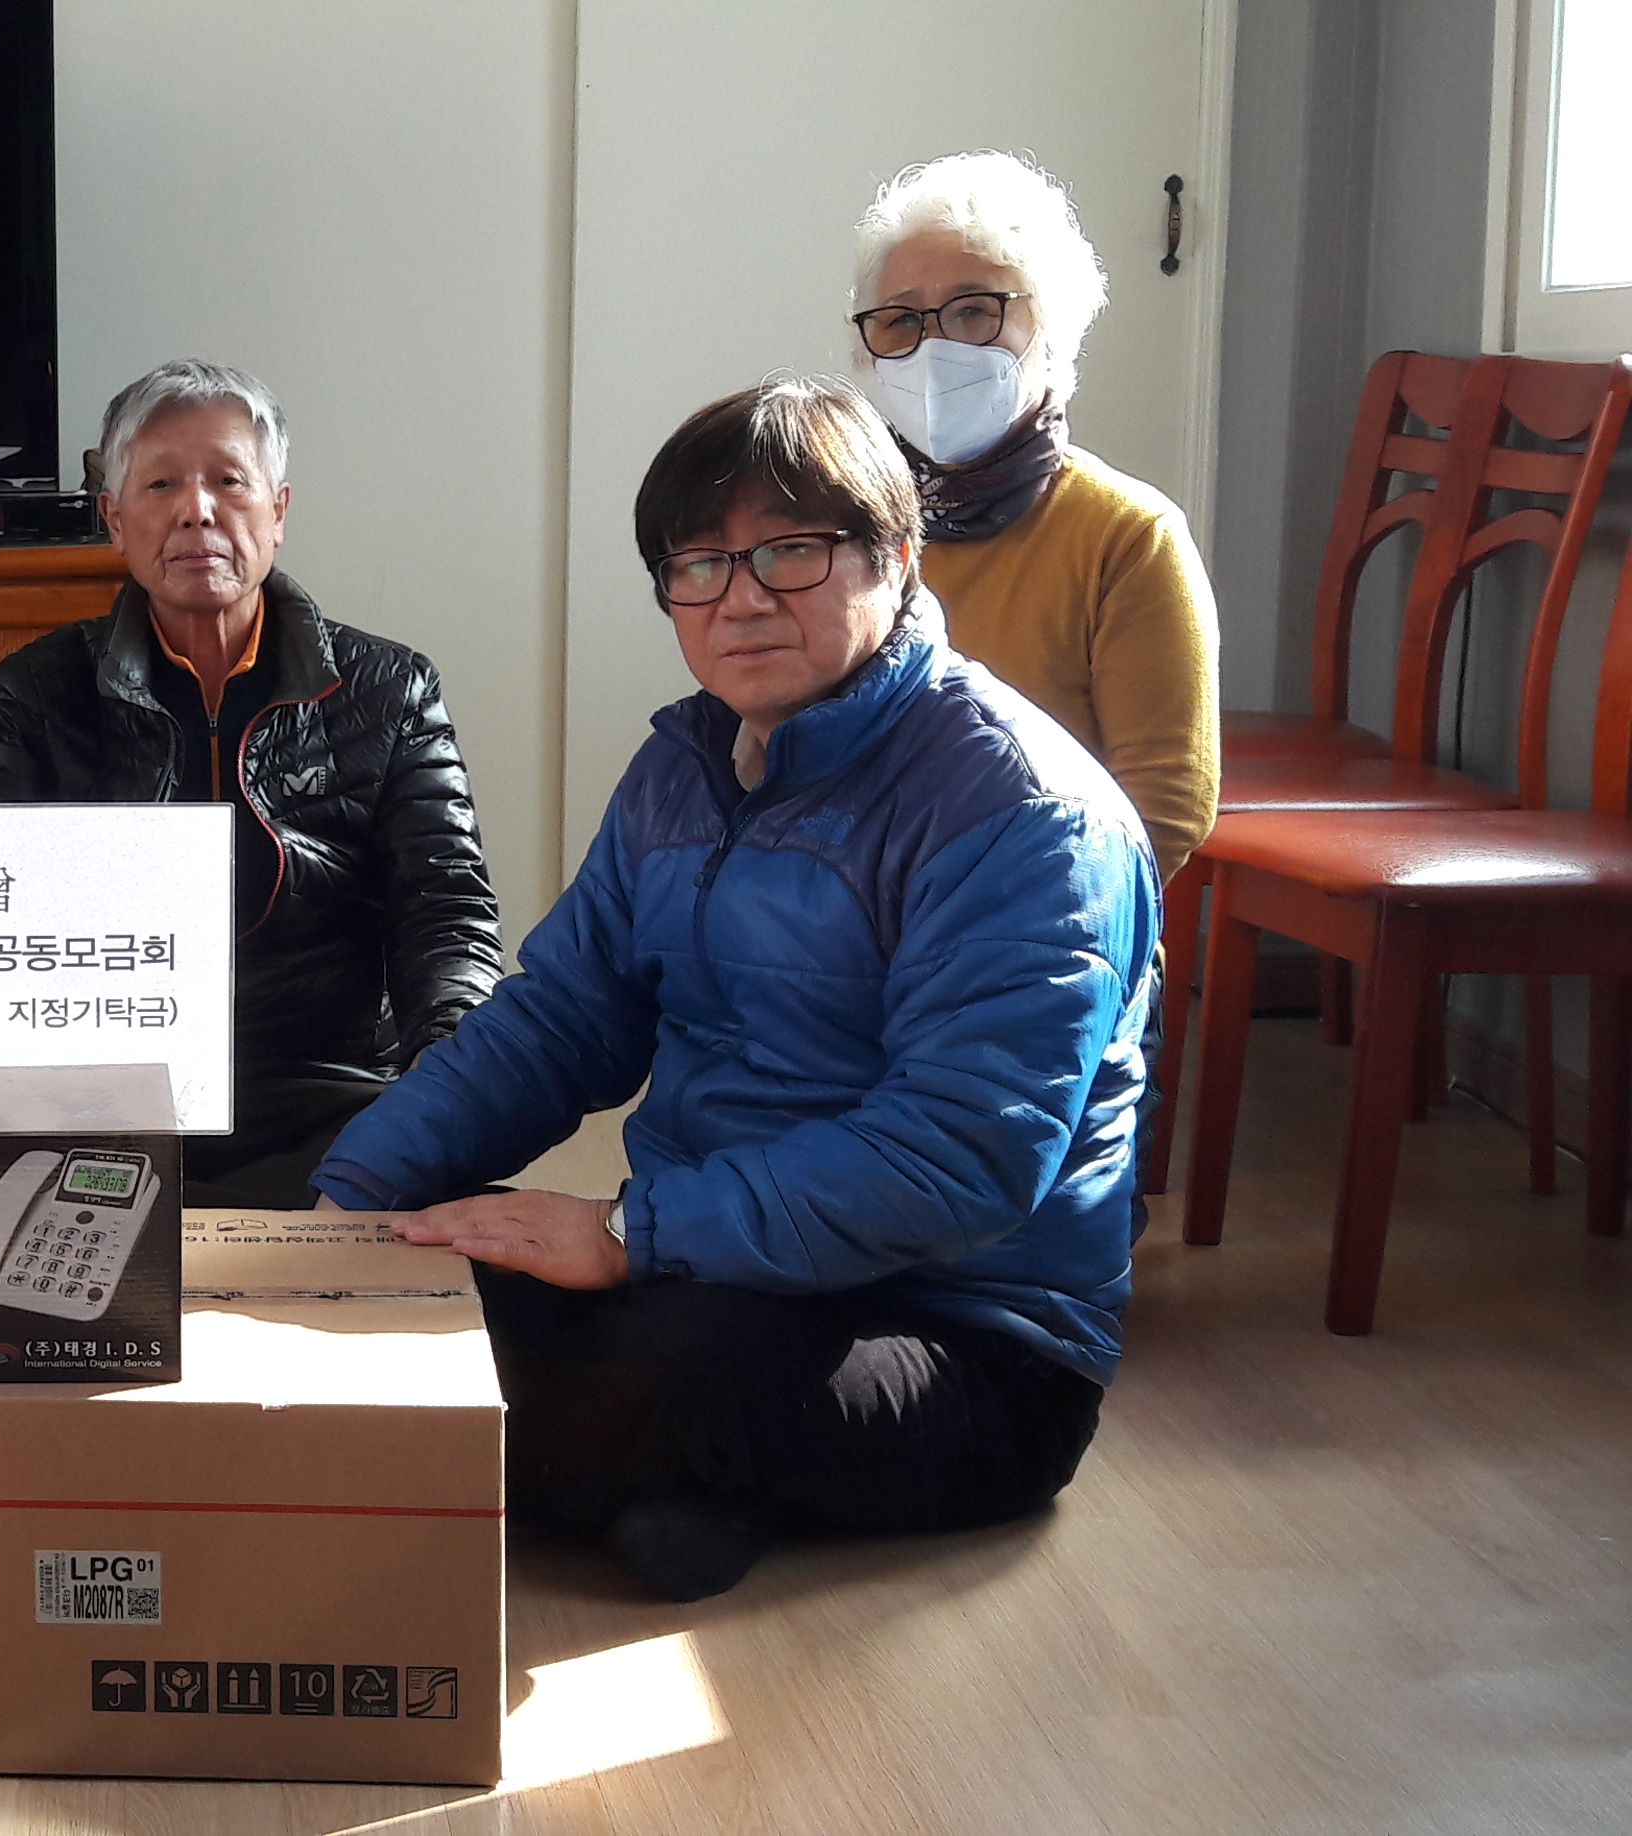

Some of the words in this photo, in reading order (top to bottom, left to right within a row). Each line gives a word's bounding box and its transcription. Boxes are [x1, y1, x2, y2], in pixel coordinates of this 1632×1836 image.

[8, 996, 179, 1029] 지정기탁금)
[24, 1341, 98, 1358] (주)태경
[24, 1358, 87, 1369] International
[89, 1358, 122, 1371] Digital
[123, 1358, 163, 1369] Service
[70, 1556, 134, 1582] LPG
[73, 1585, 124, 1620] M2087R
[289, 1670, 328, 1698] 10
